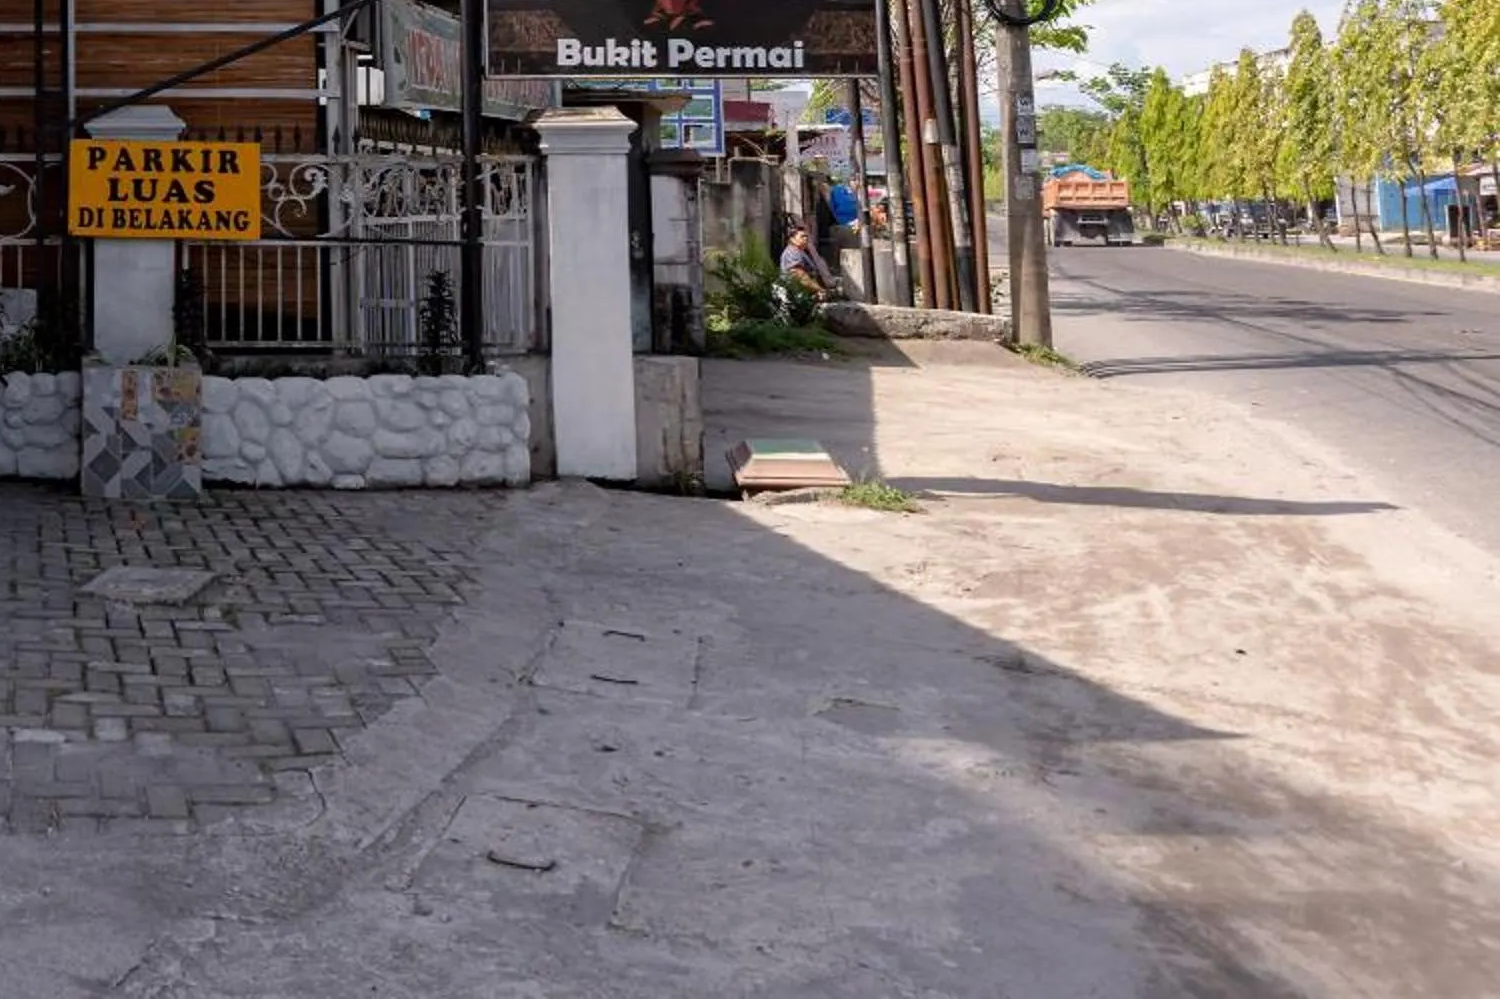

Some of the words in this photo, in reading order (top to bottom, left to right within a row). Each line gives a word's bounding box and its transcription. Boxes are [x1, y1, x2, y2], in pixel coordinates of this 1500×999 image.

[557, 38, 657, 68] Bukit
[668, 38, 805, 69] Permai
[87, 147, 240, 174] PARKIR
[108, 178, 216, 203] LUAS
[77, 207, 104, 228] DI
[112, 208, 250, 231] BELAKANG
